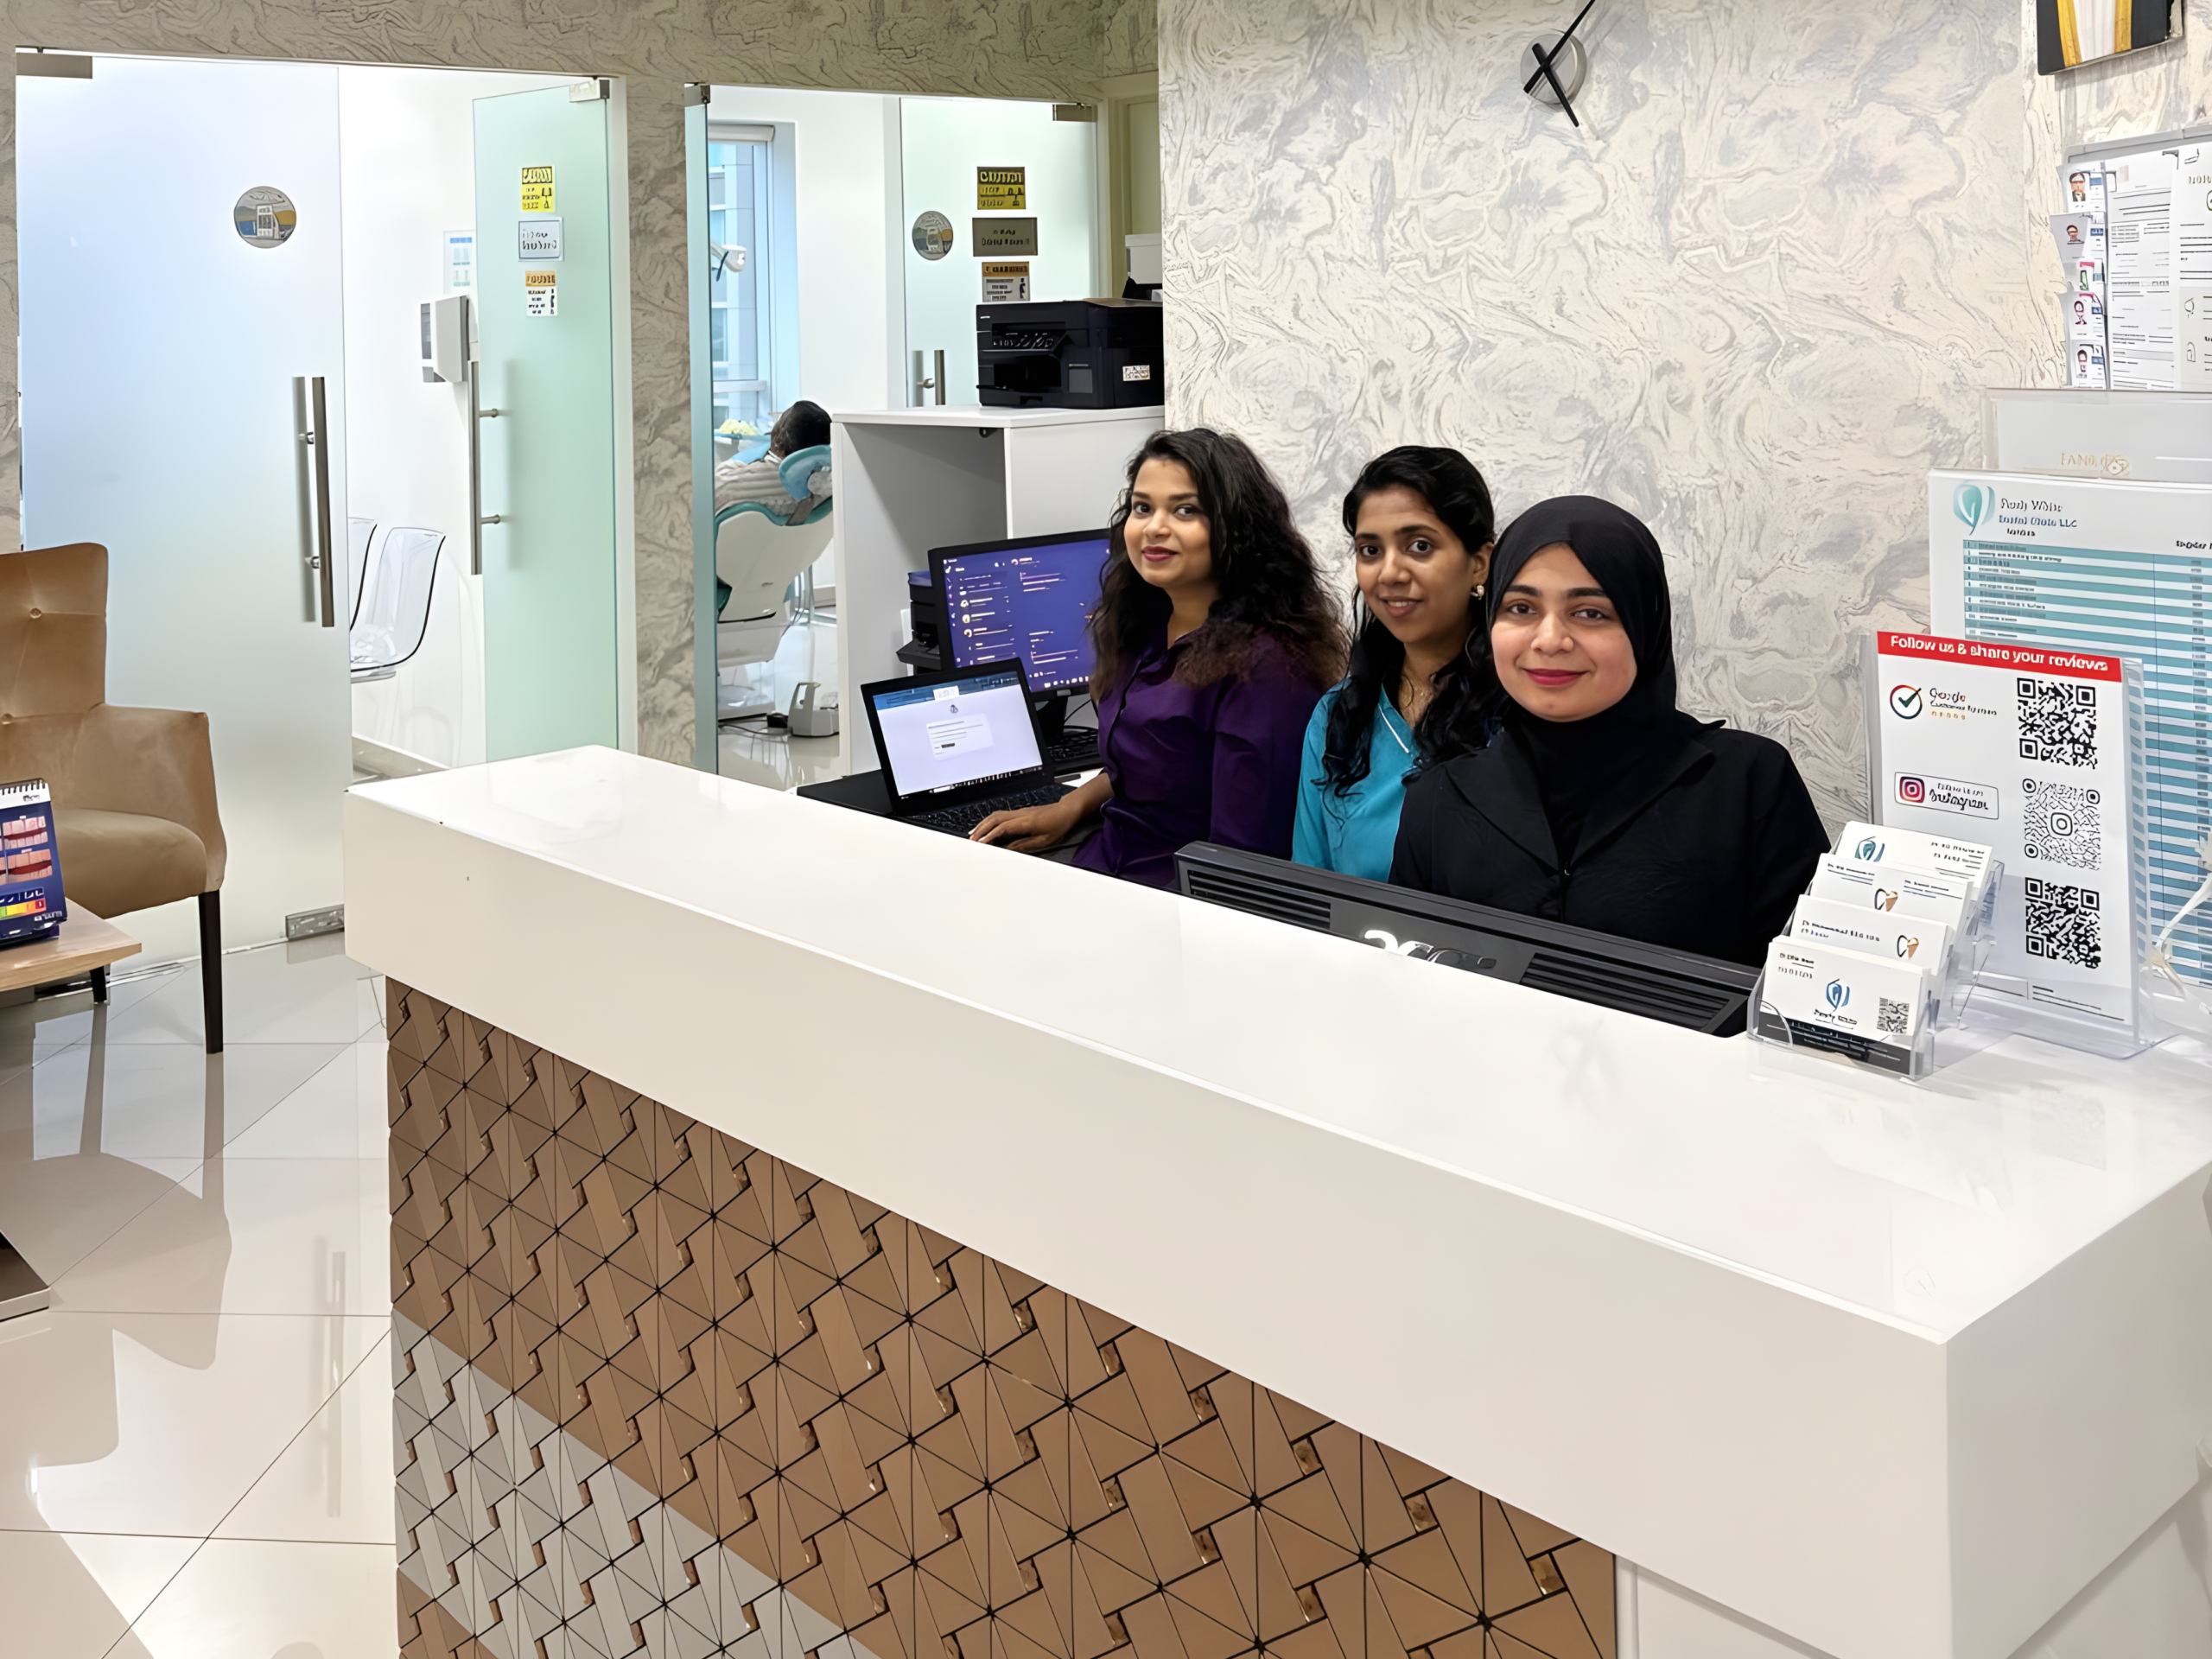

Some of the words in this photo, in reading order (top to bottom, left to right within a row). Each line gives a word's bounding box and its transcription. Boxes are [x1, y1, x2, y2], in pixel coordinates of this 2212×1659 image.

[1891, 635, 1936, 651] Follow
[1939, 642, 1955, 653] us
[1957, 645, 1967, 655] &
[1970, 646, 2010, 660] share
[2012, 652, 2046, 664] your
[2049, 654, 2108, 671] reviews
